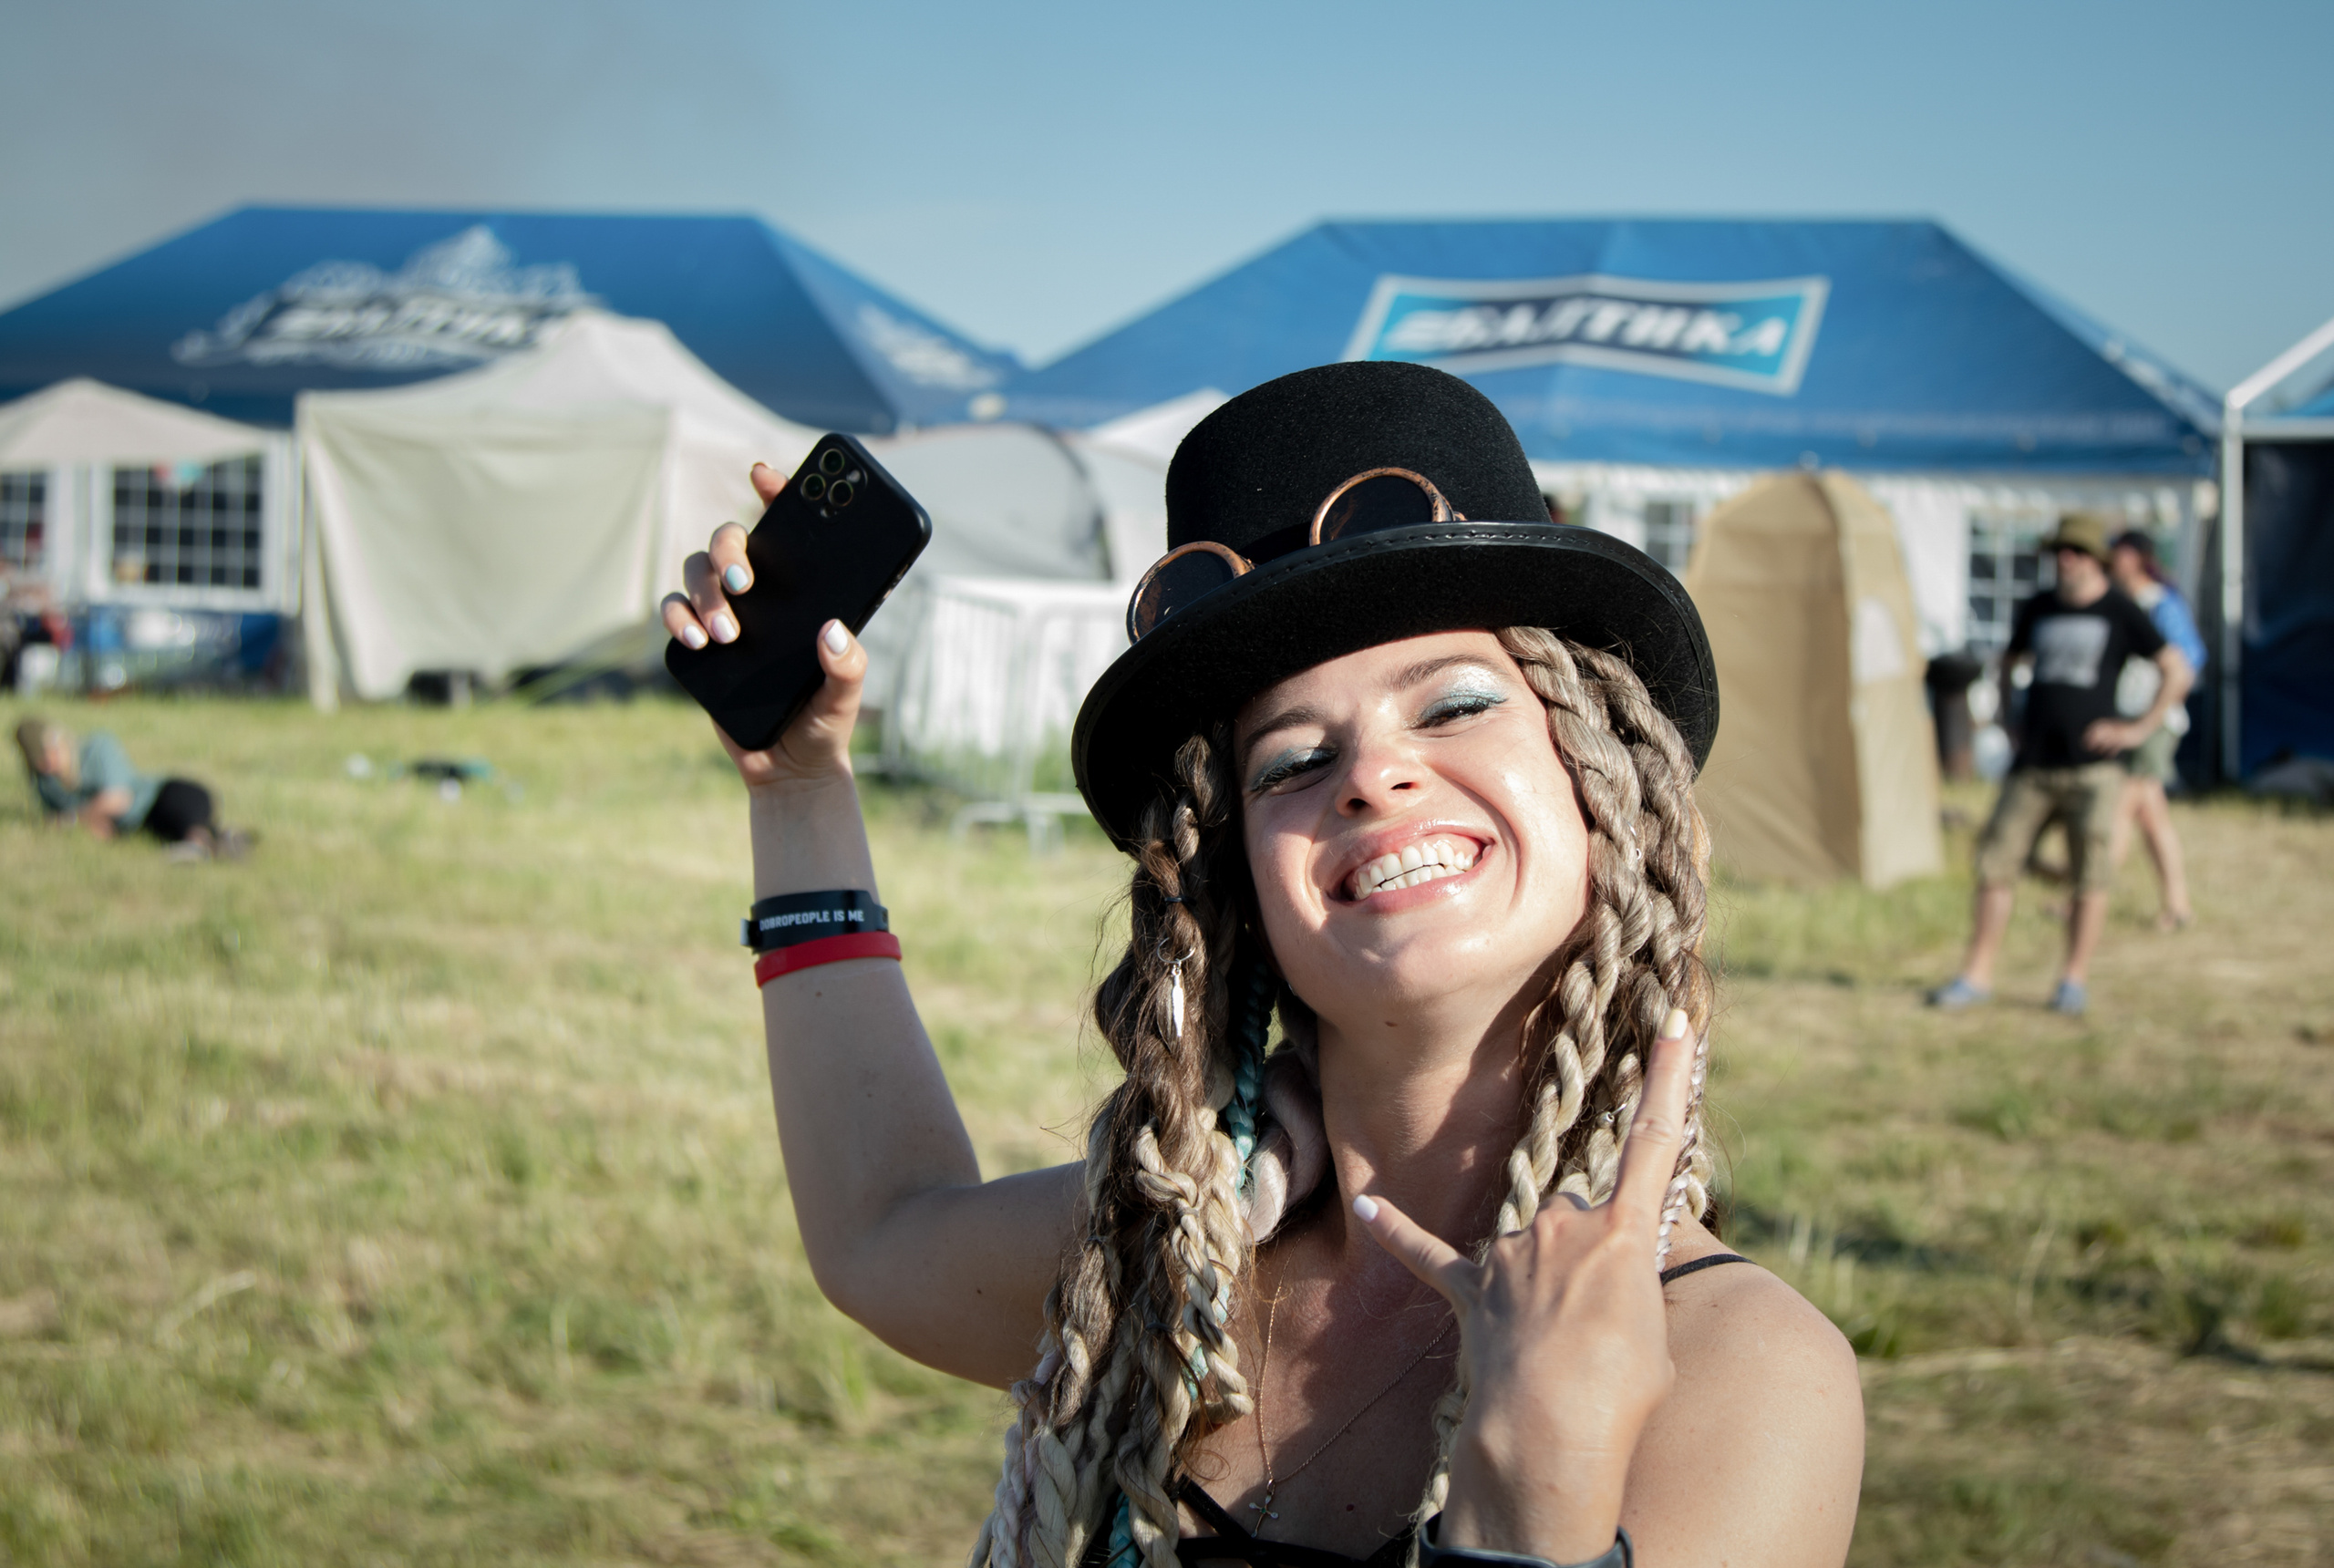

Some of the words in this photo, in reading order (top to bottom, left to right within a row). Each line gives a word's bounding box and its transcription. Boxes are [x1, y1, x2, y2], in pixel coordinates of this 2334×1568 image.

[759, 911, 831, 931] DOBROPEOPLE
[833, 910, 845, 922] IS
[848, 910, 864, 922] ME
